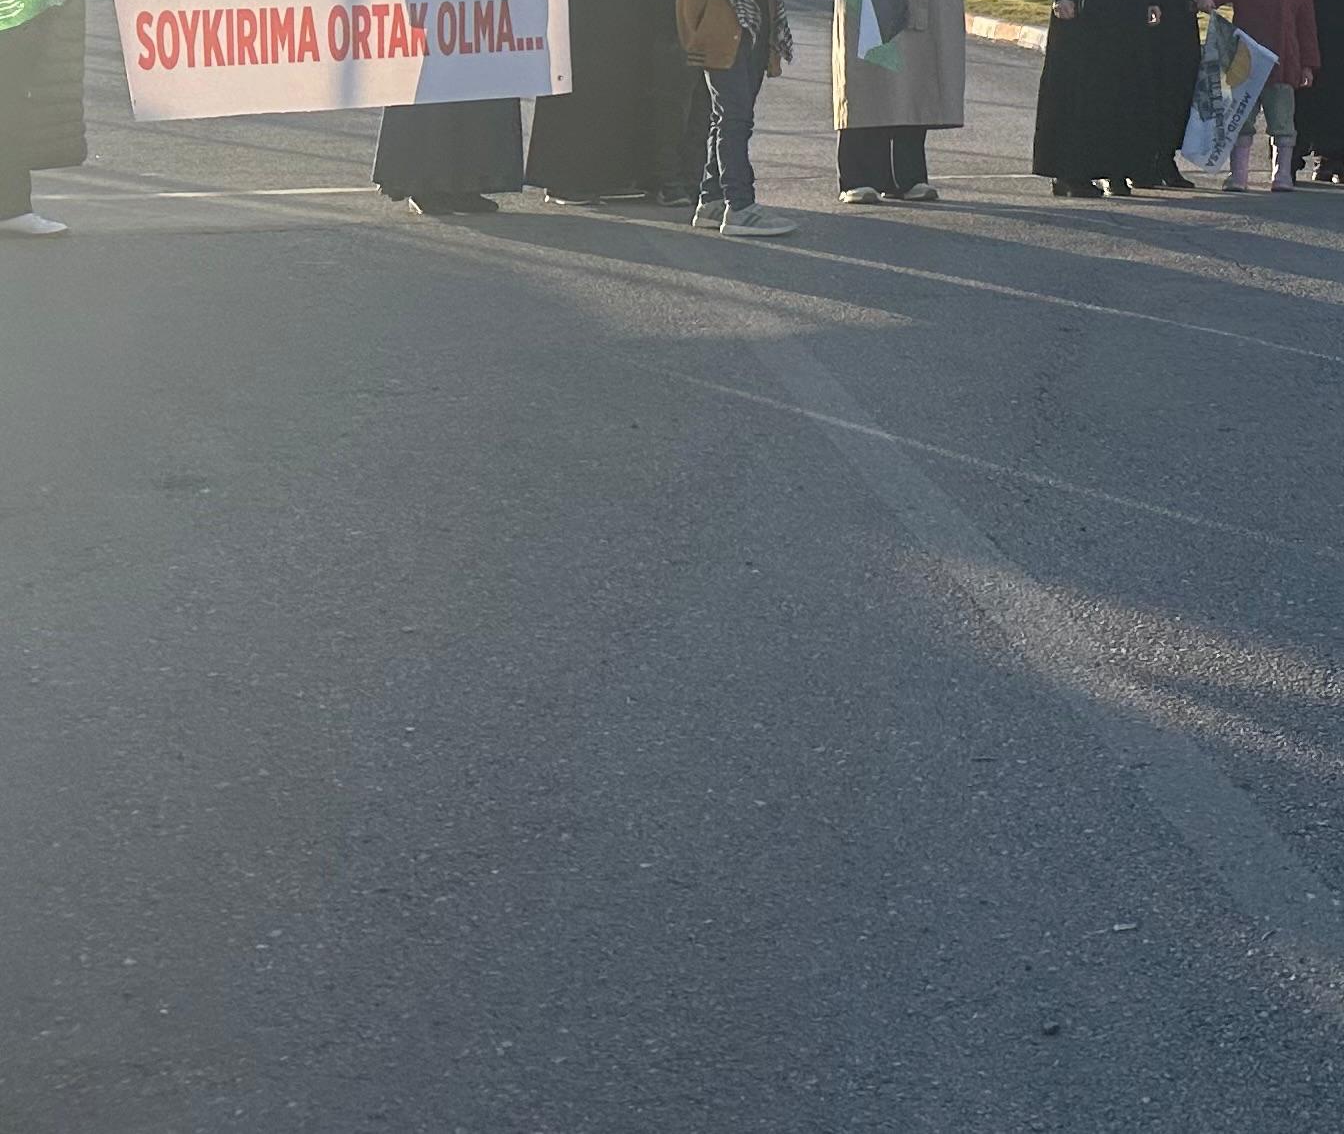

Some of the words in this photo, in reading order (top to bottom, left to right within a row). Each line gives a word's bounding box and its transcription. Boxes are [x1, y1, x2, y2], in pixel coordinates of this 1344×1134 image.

[136, 6, 321, 71] SOYKIRIMA
[327, 2, 430, 62] ORTAK
[437, 0, 544, 56] OLMA...
